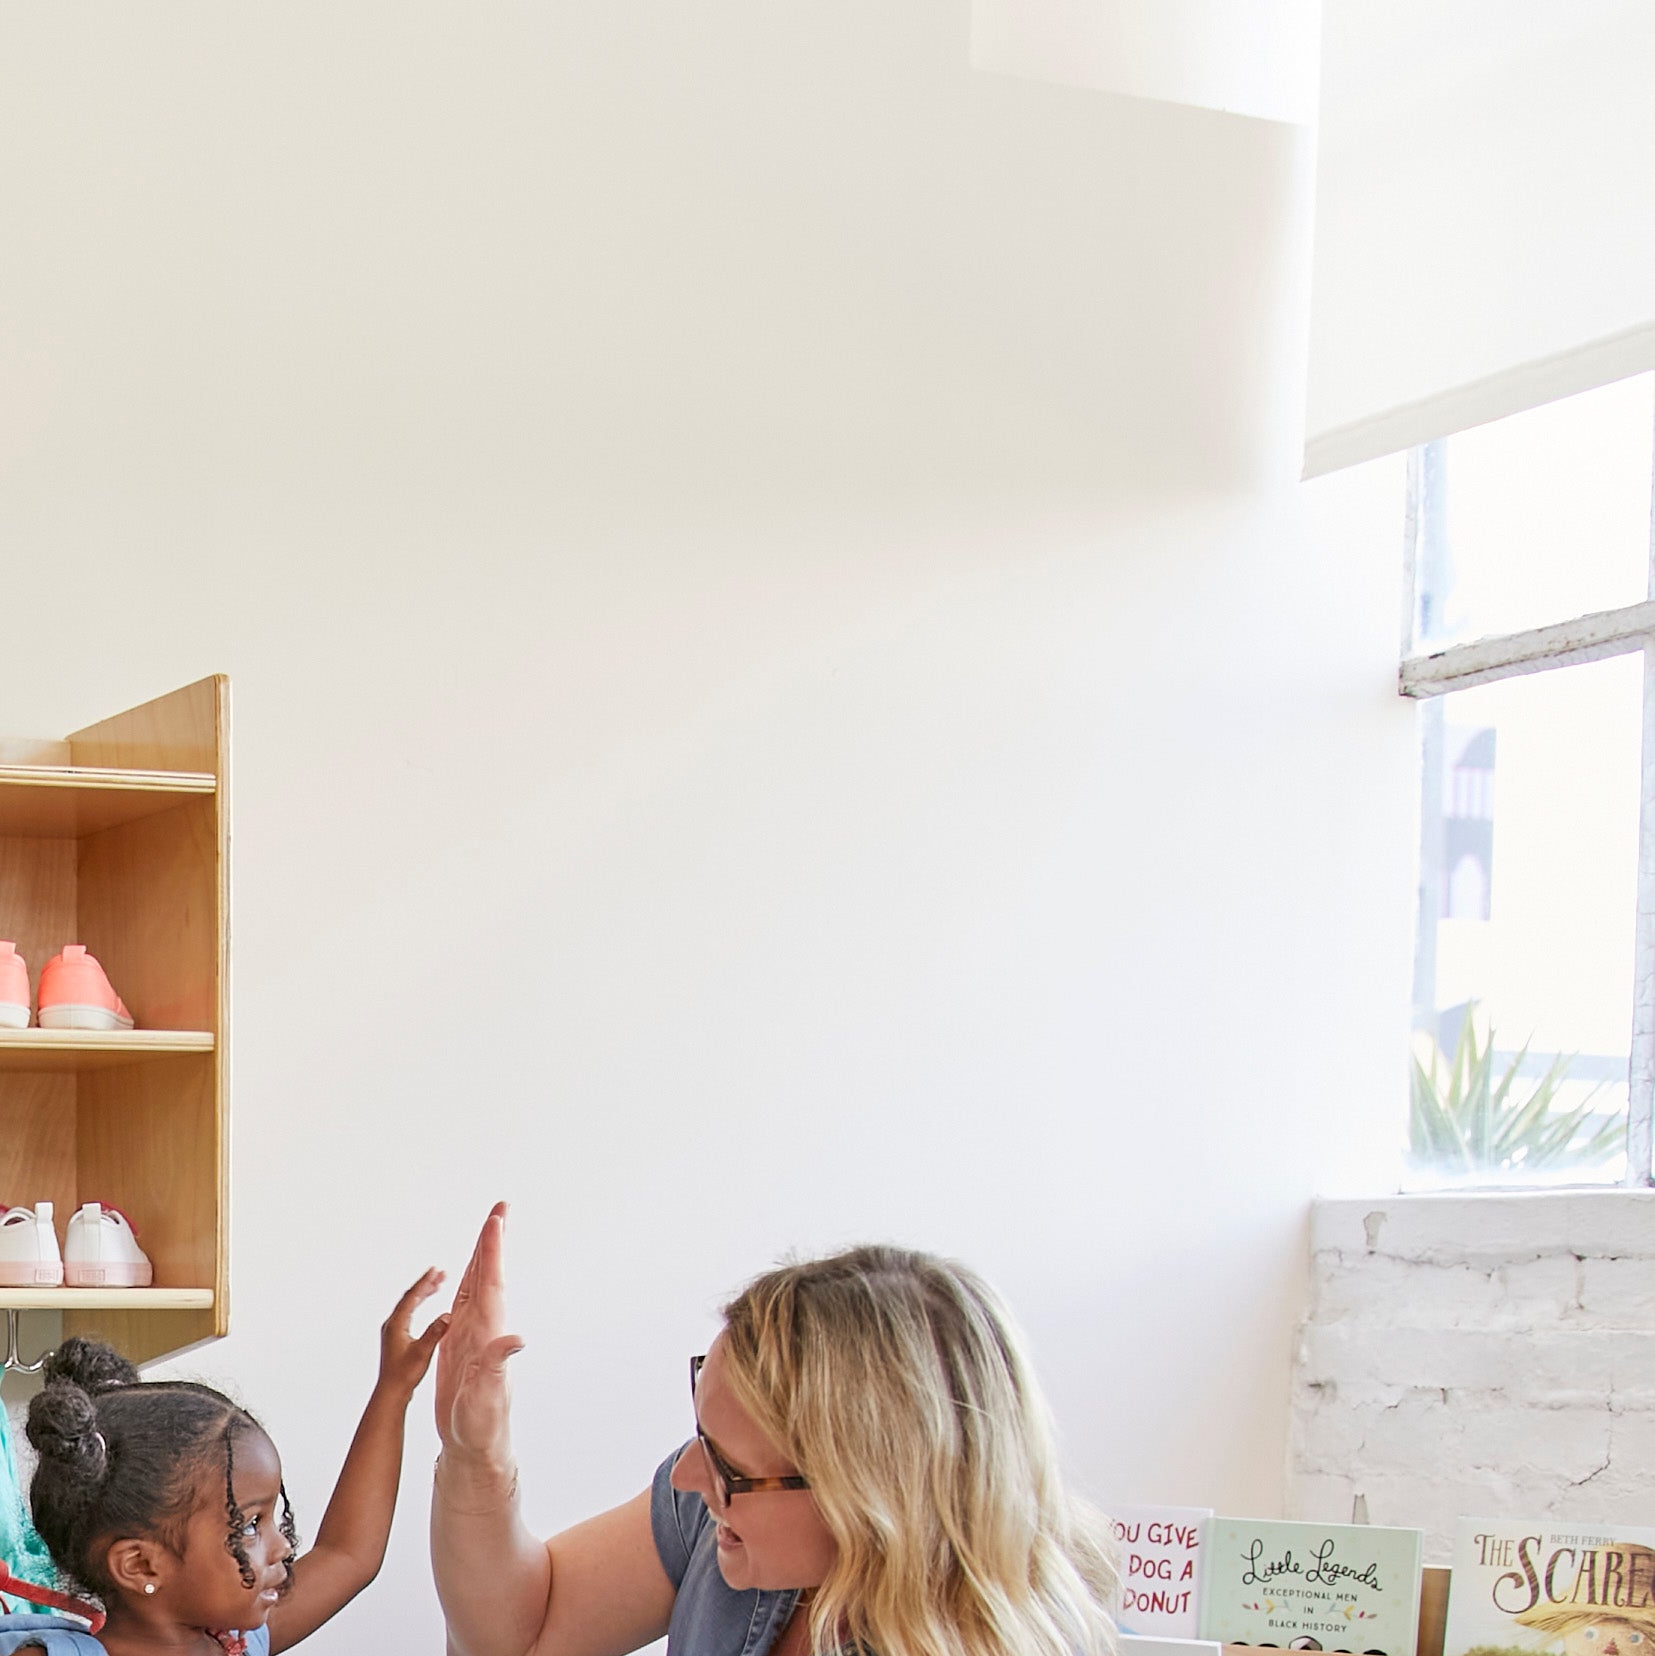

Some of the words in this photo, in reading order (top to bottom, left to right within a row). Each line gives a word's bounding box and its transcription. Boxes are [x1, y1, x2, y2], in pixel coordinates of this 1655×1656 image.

[1148, 1523, 1199, 1549] GIVE
[1550, 1534, 1579, 1545] BETH
[1581, 1535, 1616, 1547] FERRY
[1474, 1534, 1515, 1567] THE
[1129, 1554, 1172, 1580] DOG
[1179, 1560, 1193, 1581] A
[1240, 1538, 1304, 1585] Little
[1305, 1538, 1383, 1591] Legends
[1493, 1534, 1655, 1614] SCARE
[1123, 1587, 1191, 1614] DONUT
[1262, 1587, 1331, 1600] EXCEPTIONAL
[1336, 1592, 1358, 1602] MEN
[1303, 1605, 1314, 1615] IN
[1268, 1619, 1297, 1629] BLACK
[1302, 1622, 1347, 1633] HISTORY
